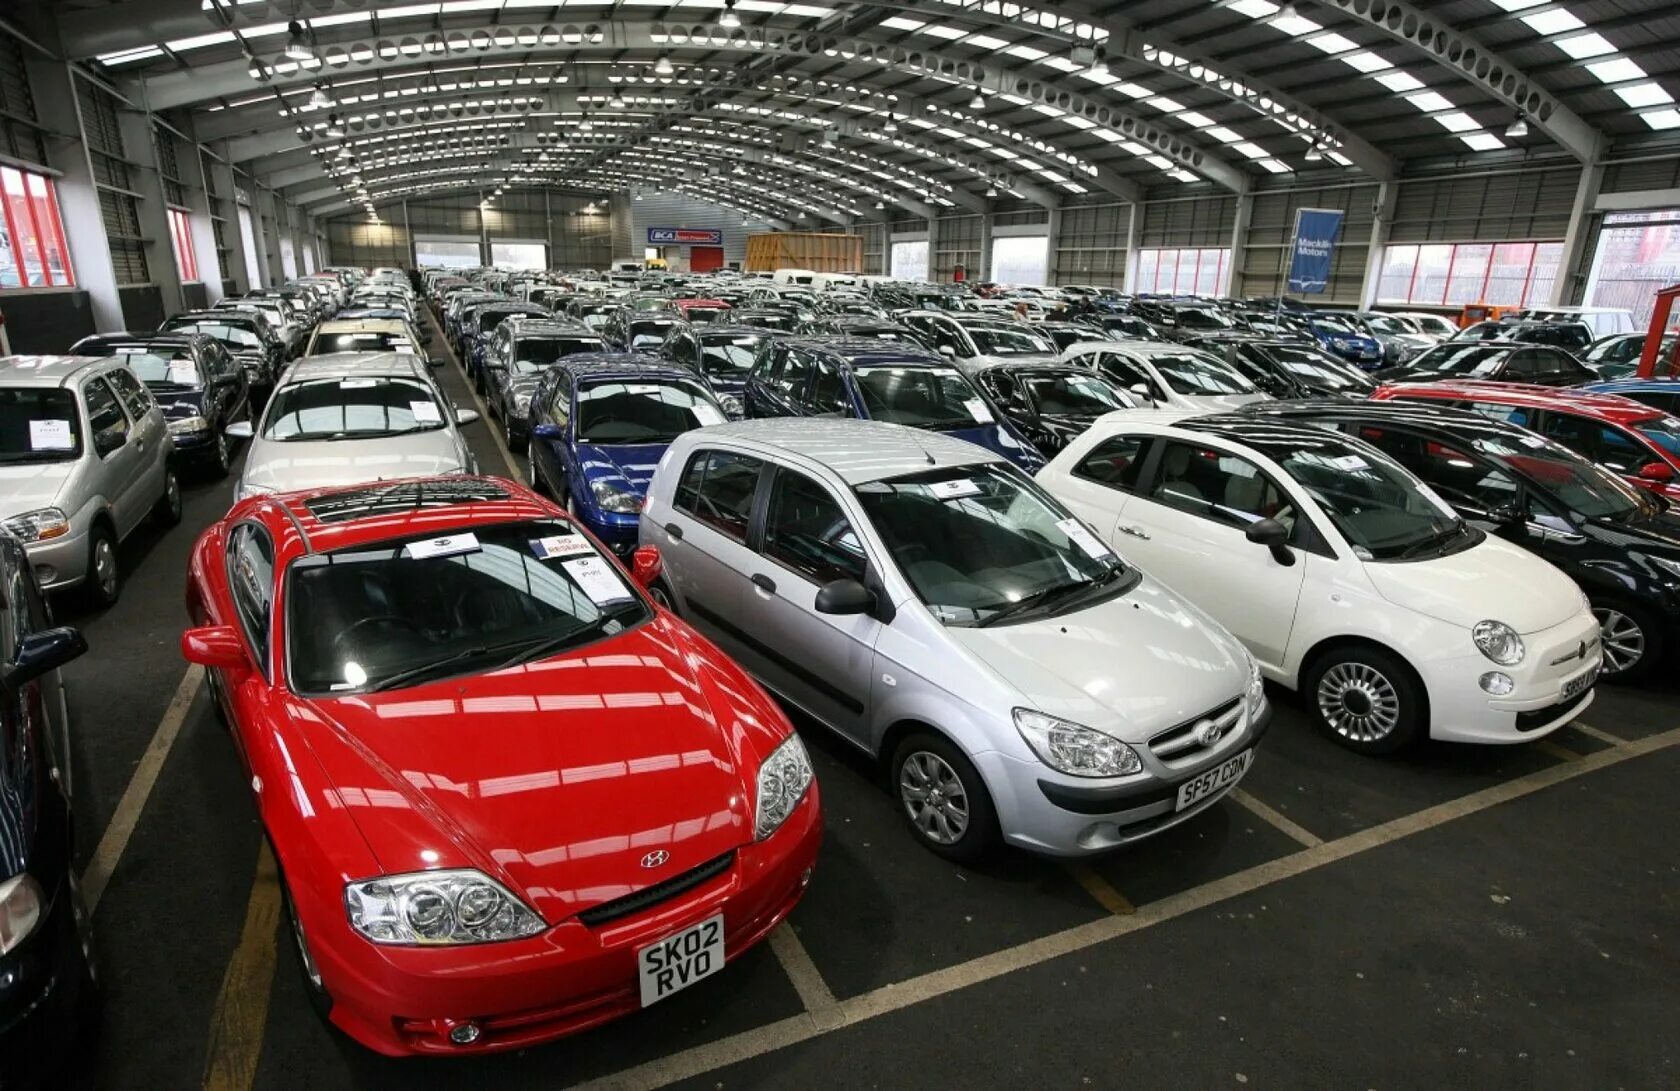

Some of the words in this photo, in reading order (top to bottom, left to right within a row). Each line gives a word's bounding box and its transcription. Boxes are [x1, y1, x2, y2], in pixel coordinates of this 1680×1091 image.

[654, 231, 673, 239] BCA
[1298, 238, 1332, 248] Macklin
[1298, 247, 1328, 256] Motors
[548, 543, 589, 552] RESERVE
[1184, 768, 1220, 803] SP57
[646, 921, 719, 974] SK02
[657, 951, 710, 996] RVO
